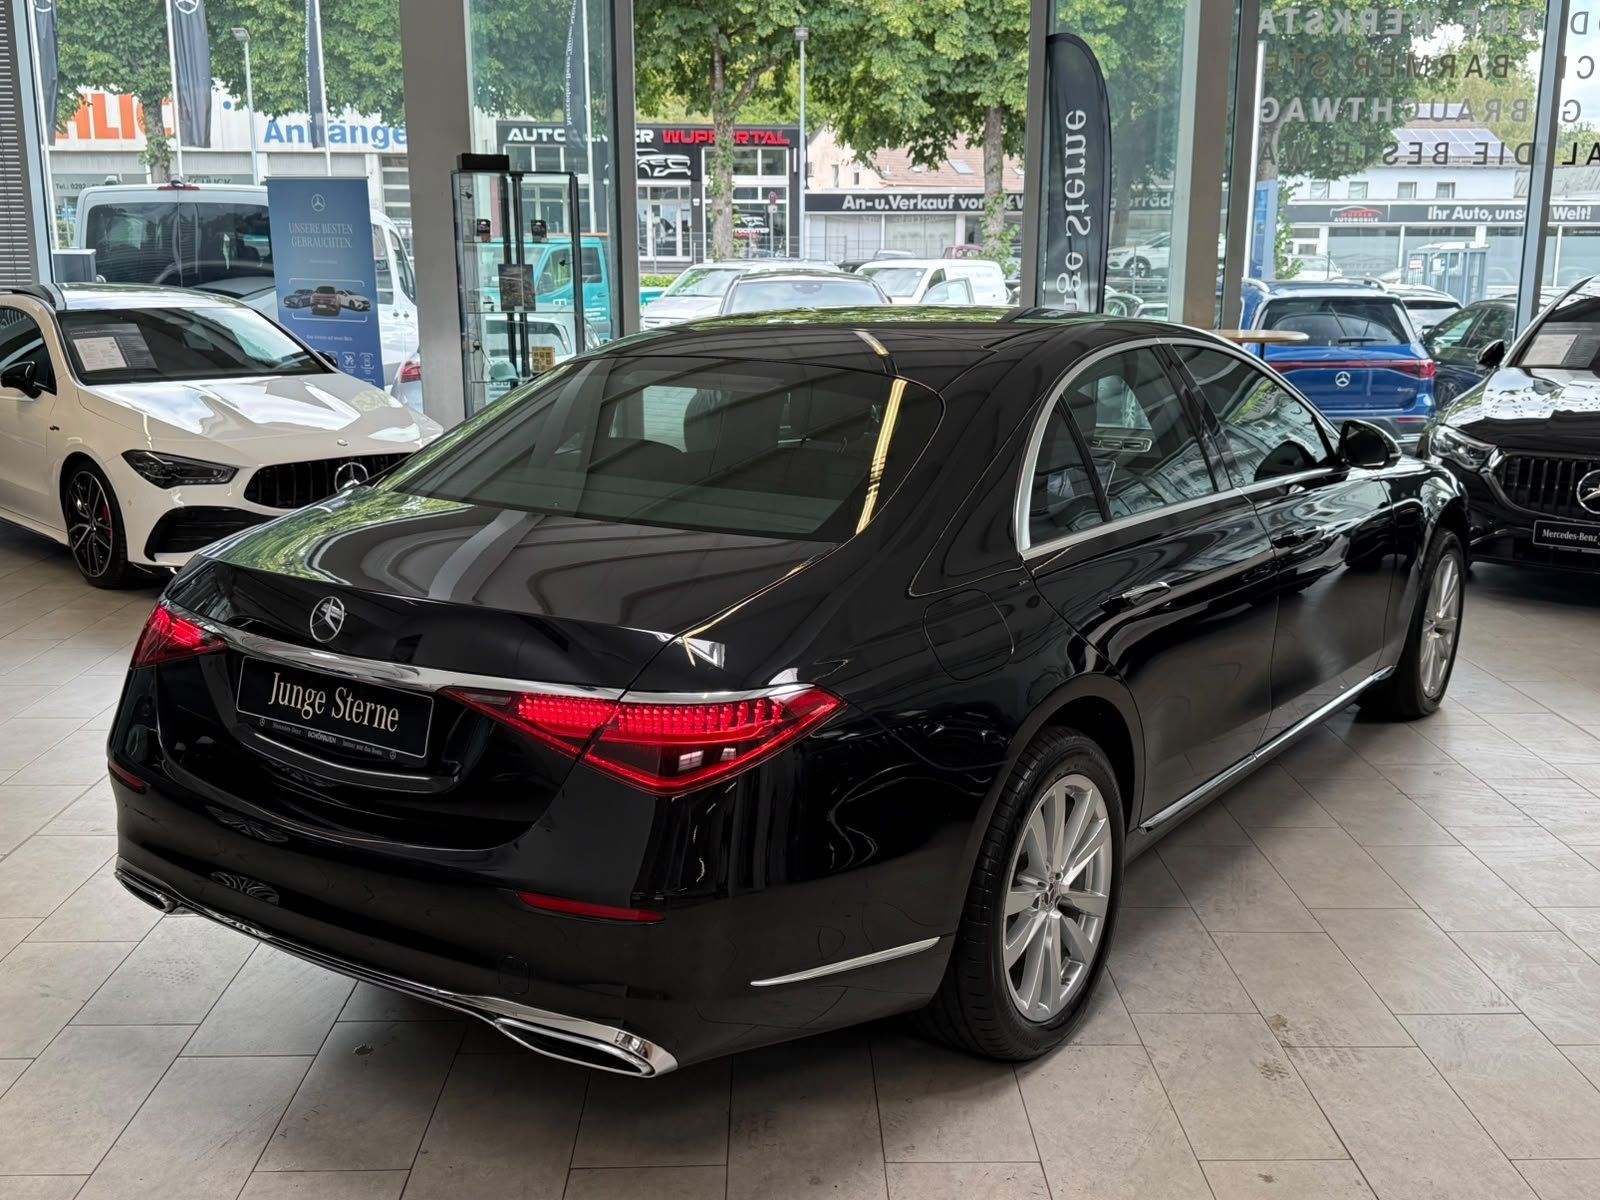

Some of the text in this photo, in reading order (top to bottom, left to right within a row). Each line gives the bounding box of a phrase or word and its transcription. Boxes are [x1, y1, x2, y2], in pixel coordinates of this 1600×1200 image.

[662, 130, 790, 145] WUPRTAL
[1427, 206, 1450, 220] Ihr
[1552, 206, 1592, 220] Welt!
[288, 222, 353, 234] UNSERE BESTEN
[1542, 529, 1598, 542] Mercedes-Benz
[268, 672, 399, 732] Junge Sterne
